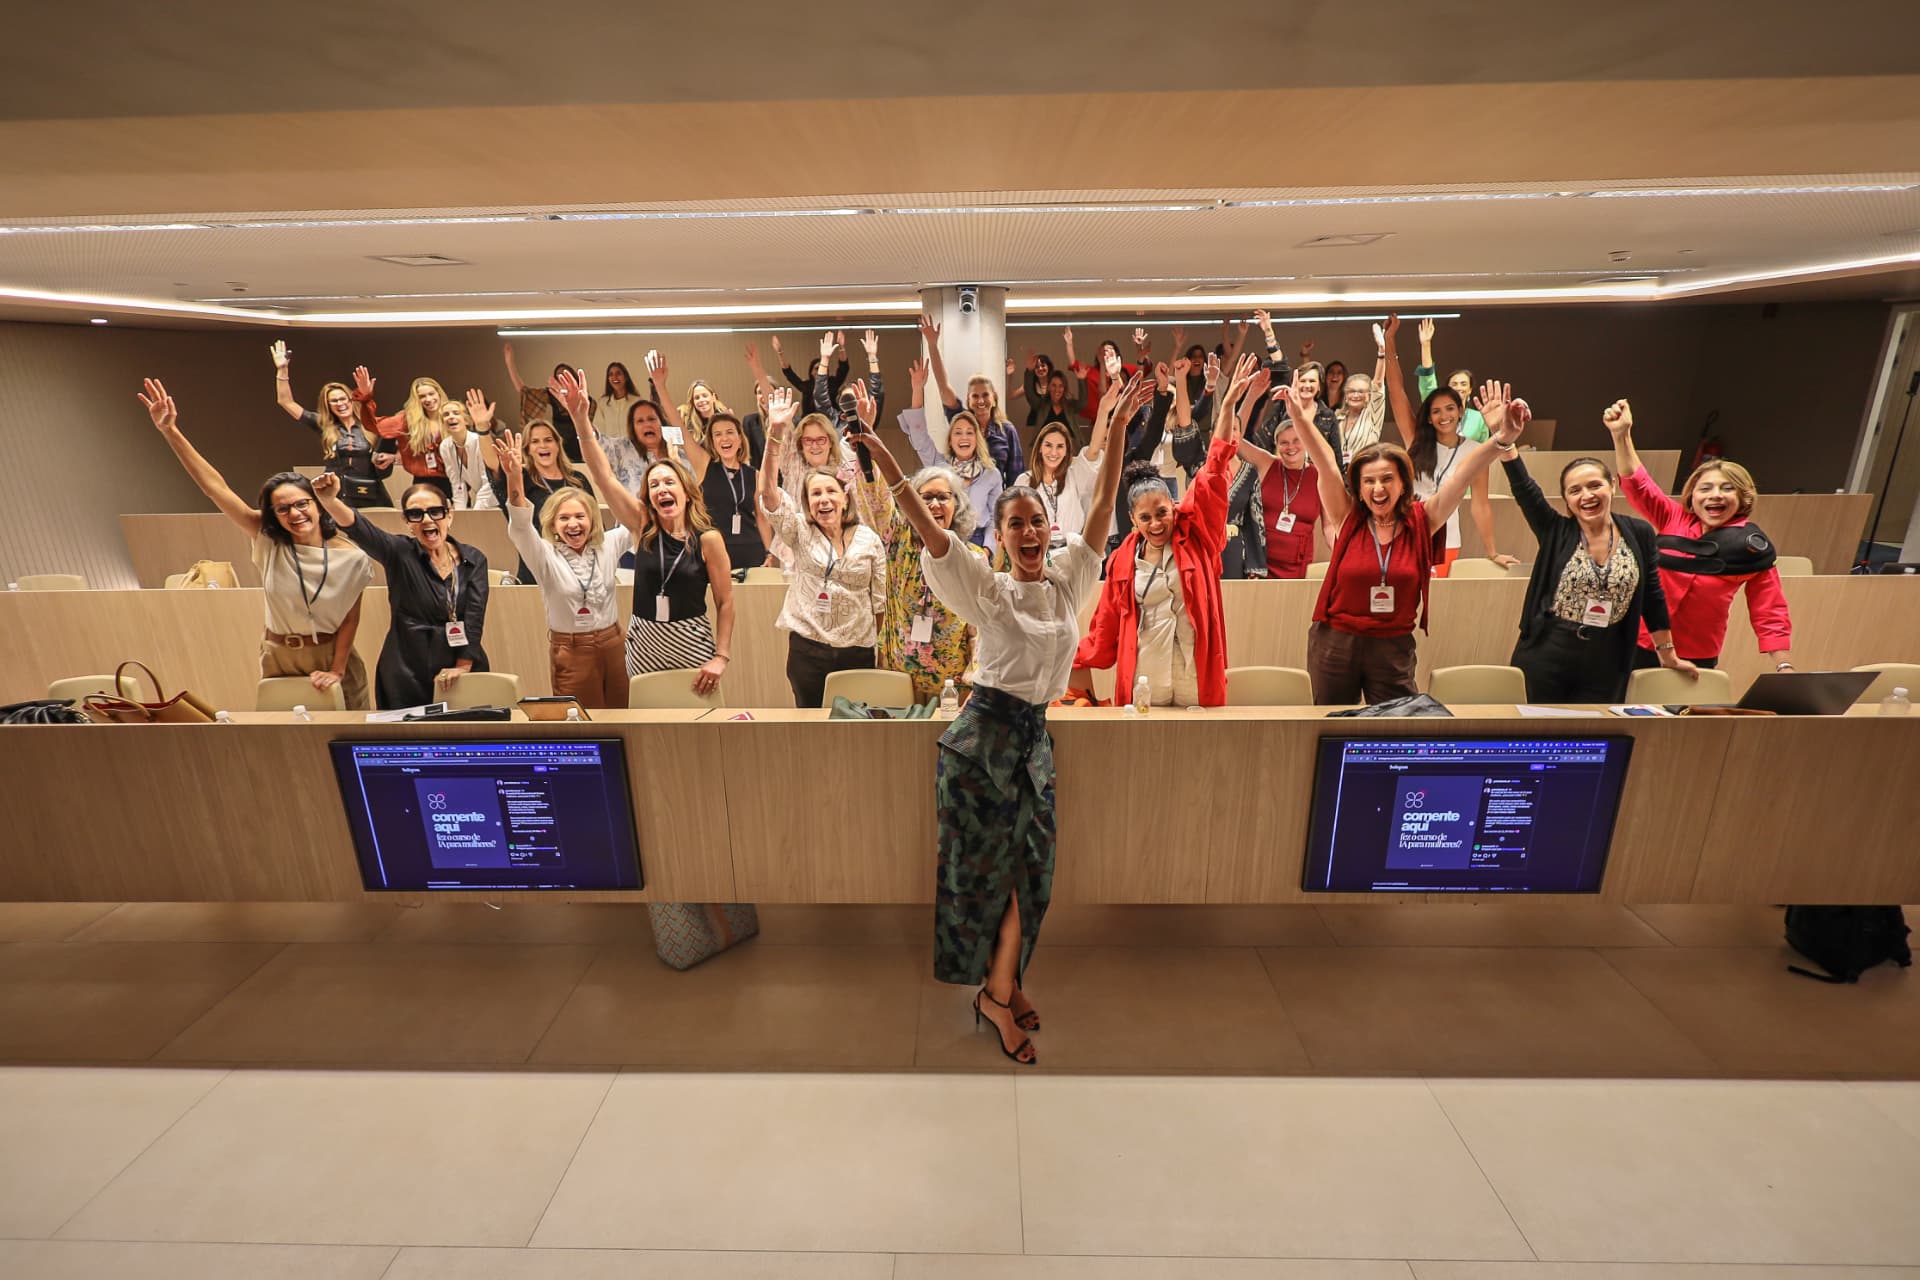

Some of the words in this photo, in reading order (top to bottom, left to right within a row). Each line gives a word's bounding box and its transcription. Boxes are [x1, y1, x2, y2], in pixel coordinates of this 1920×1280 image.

[432, 812, 485, 822] comente
[1403, 811, 1460, 822] comente
[434, 821, 460, 834] aqui
[1401, 821, 1429, 833] aqui
